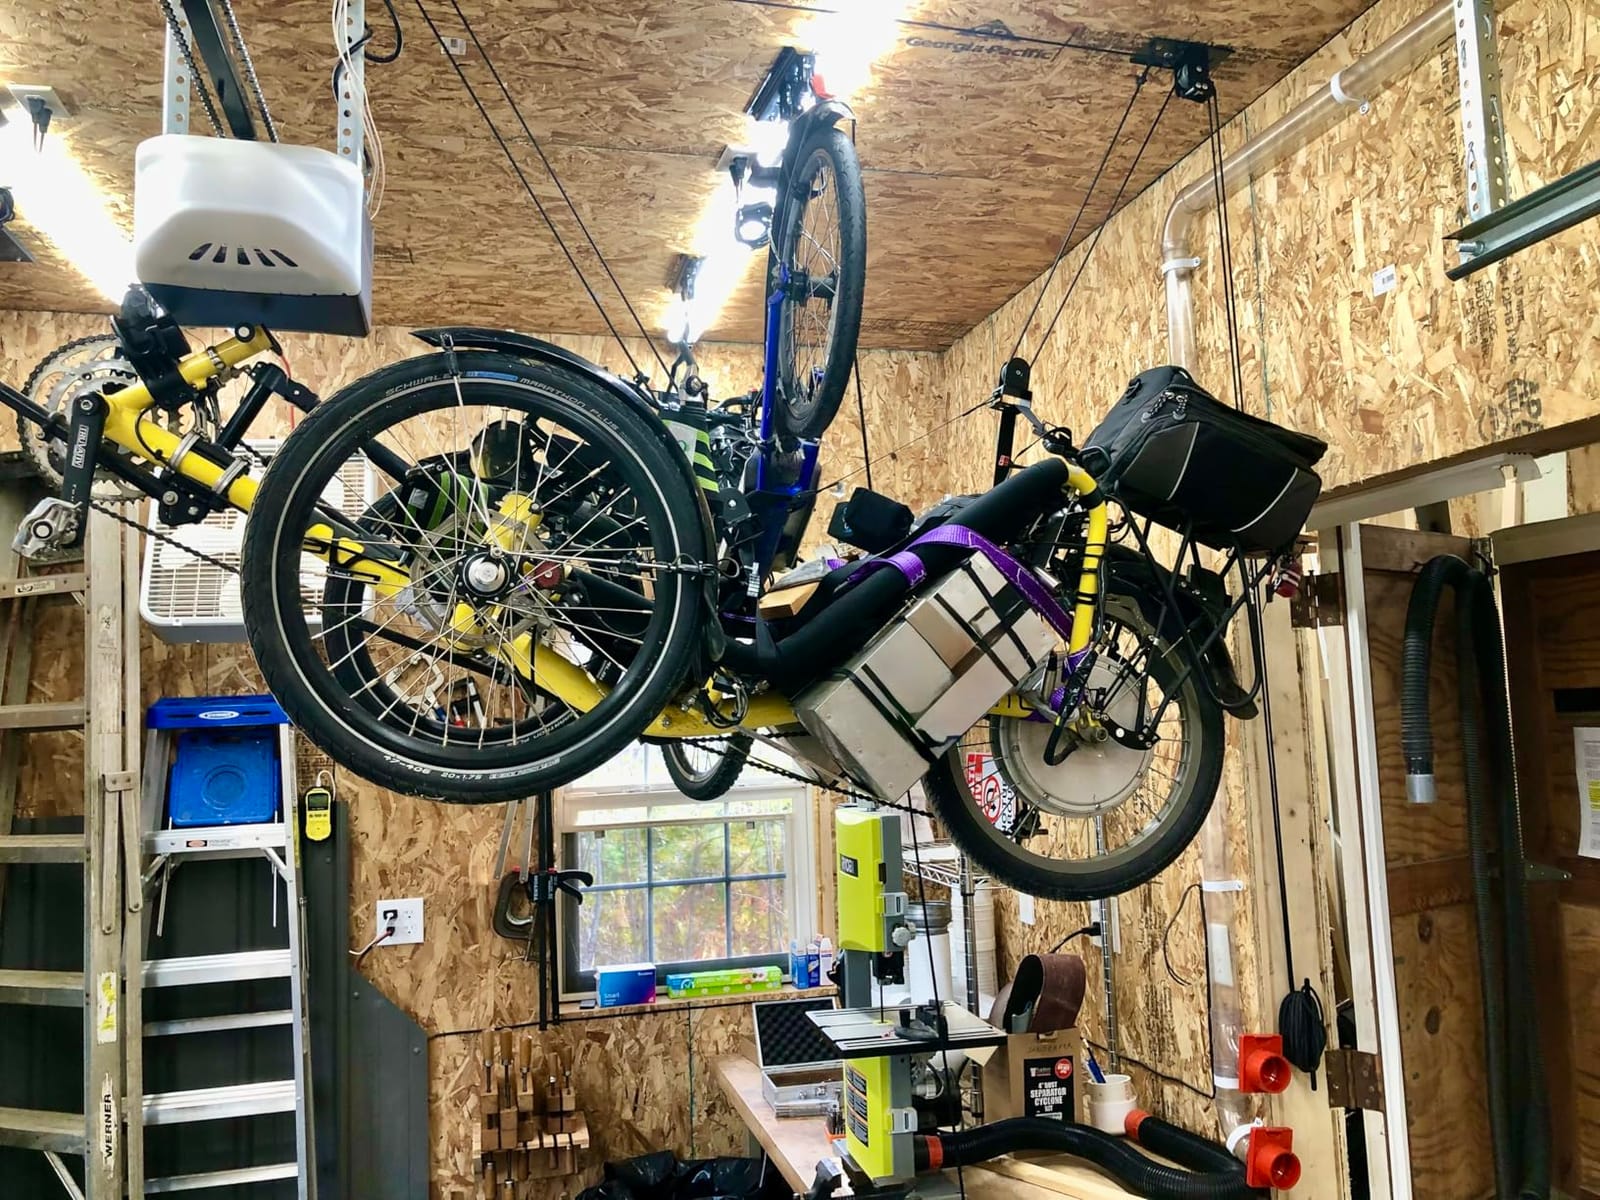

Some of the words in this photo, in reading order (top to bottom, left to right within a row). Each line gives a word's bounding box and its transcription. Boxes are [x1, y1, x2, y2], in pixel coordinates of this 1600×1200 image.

[905, 36, 1053, 60] Georgia-Pacific
[520, 378, 586, 409] MARATHON
[590, 408, 619, 431] PLUS
[1030, 1087, 1067, 1099] SEPARATOR
[1034, 1095, 1063, 1107] CYCLONE
[103, 1094, 113, 1158] WERNER
